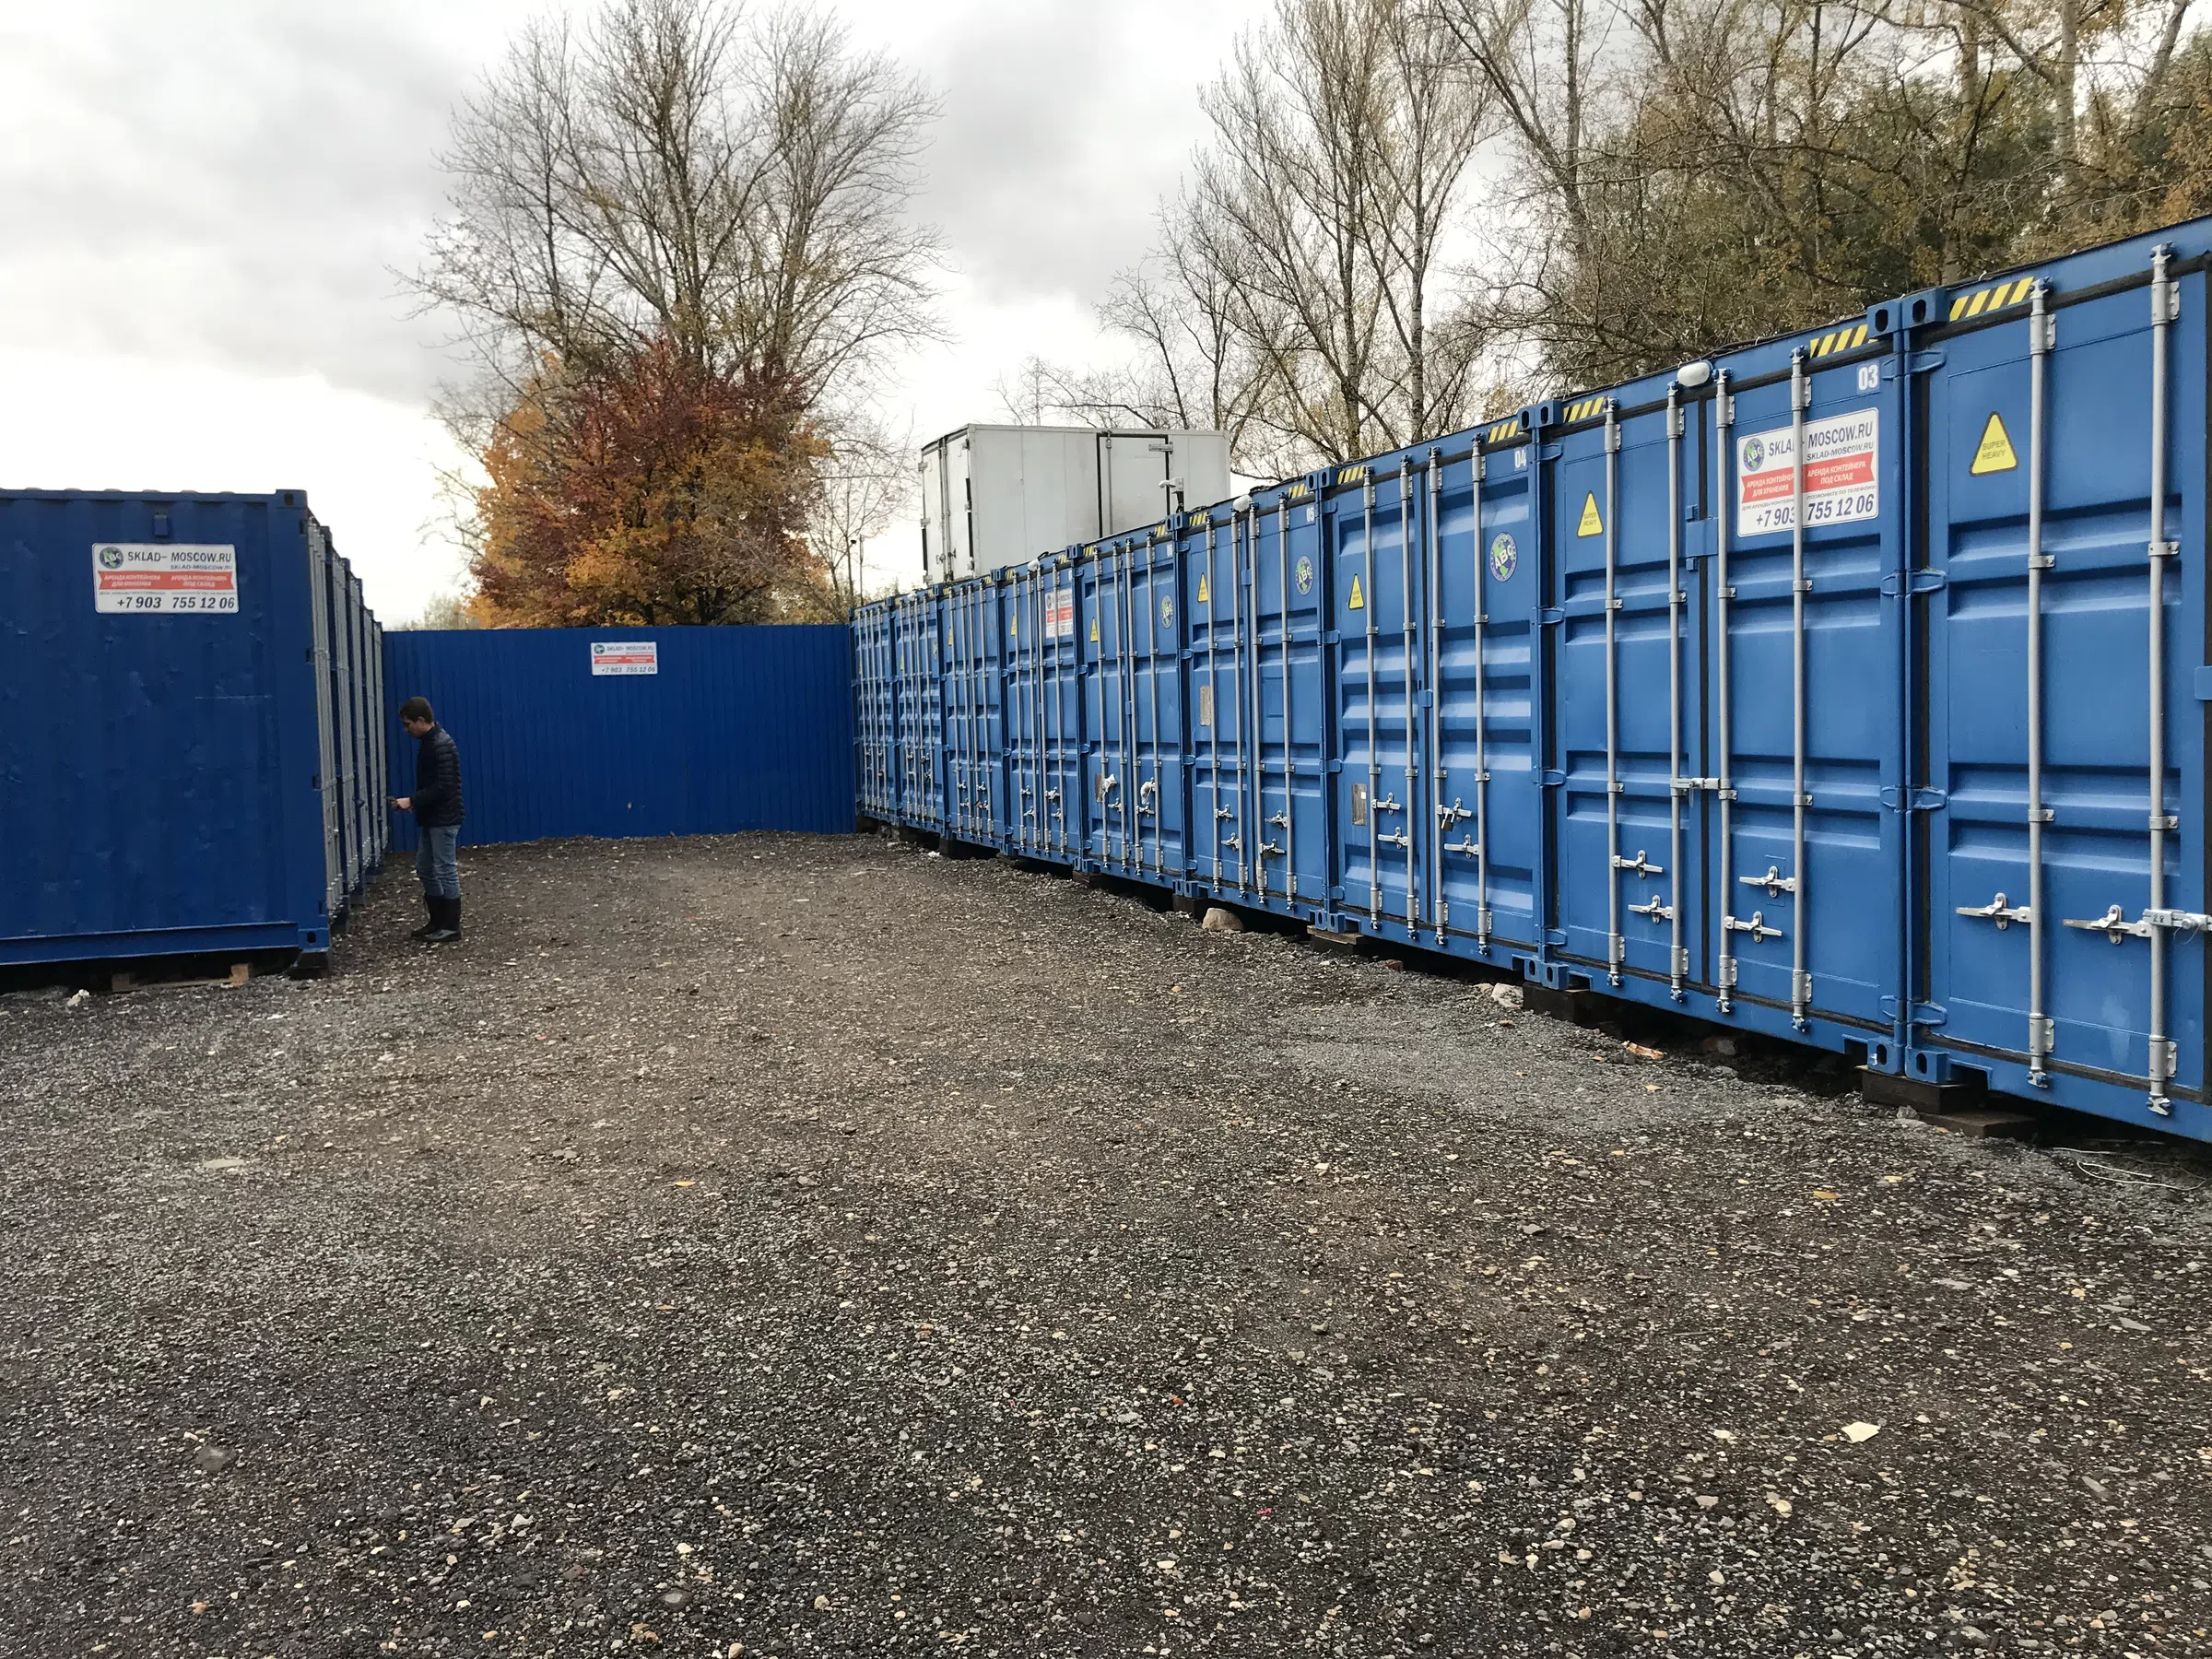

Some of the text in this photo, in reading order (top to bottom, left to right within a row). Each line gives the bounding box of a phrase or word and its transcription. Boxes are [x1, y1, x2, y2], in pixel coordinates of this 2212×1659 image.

[1858, 364, 1878, 391] 03
[1769, 420, 1874, 457] SKLA- MOSCOW.RU
[1982, 439, 2006, 451] SUPER
[1514, 449, 1527, 468] 04
[1806, 441, 1875, 462] SKLAD-MOSCOW.RU
[1982, 449, 2006, 461] HEAVY
[1807, 466, 1830, 478] АРЕНДА
[1756, 510, 1771, 527] +7
[1807, 500, 1833, 521] 755
[1835, 496, 1853, 517] 12
[1855, 493, 1875, 514] 06
[127, 551, 232, 563] SKLAD- MOSCOW.RU
[1495, 544, 1512, 570] ABC
[117, 596, 235, 609] +7 903 755 12 06
